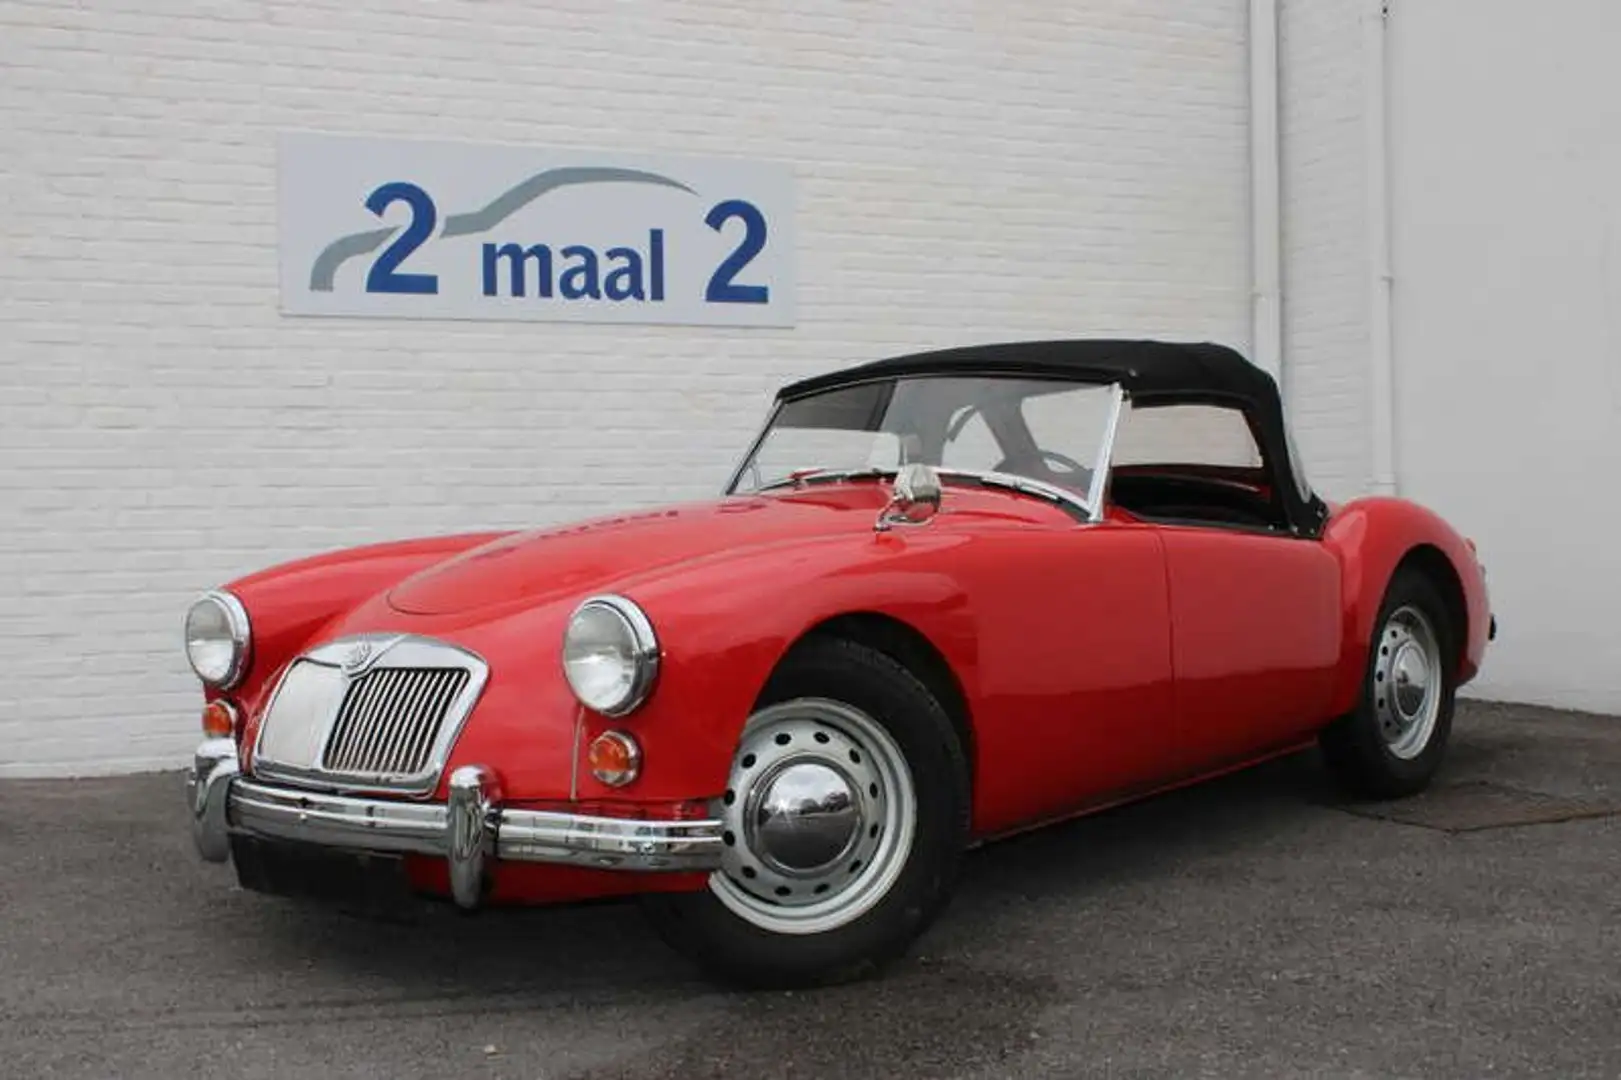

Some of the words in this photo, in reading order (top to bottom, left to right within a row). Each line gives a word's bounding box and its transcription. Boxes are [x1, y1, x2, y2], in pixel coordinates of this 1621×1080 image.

[364, 181, 438, 295] 2
[481, 228, 664, 302] maal
[704, 199, 770, 304] 2
